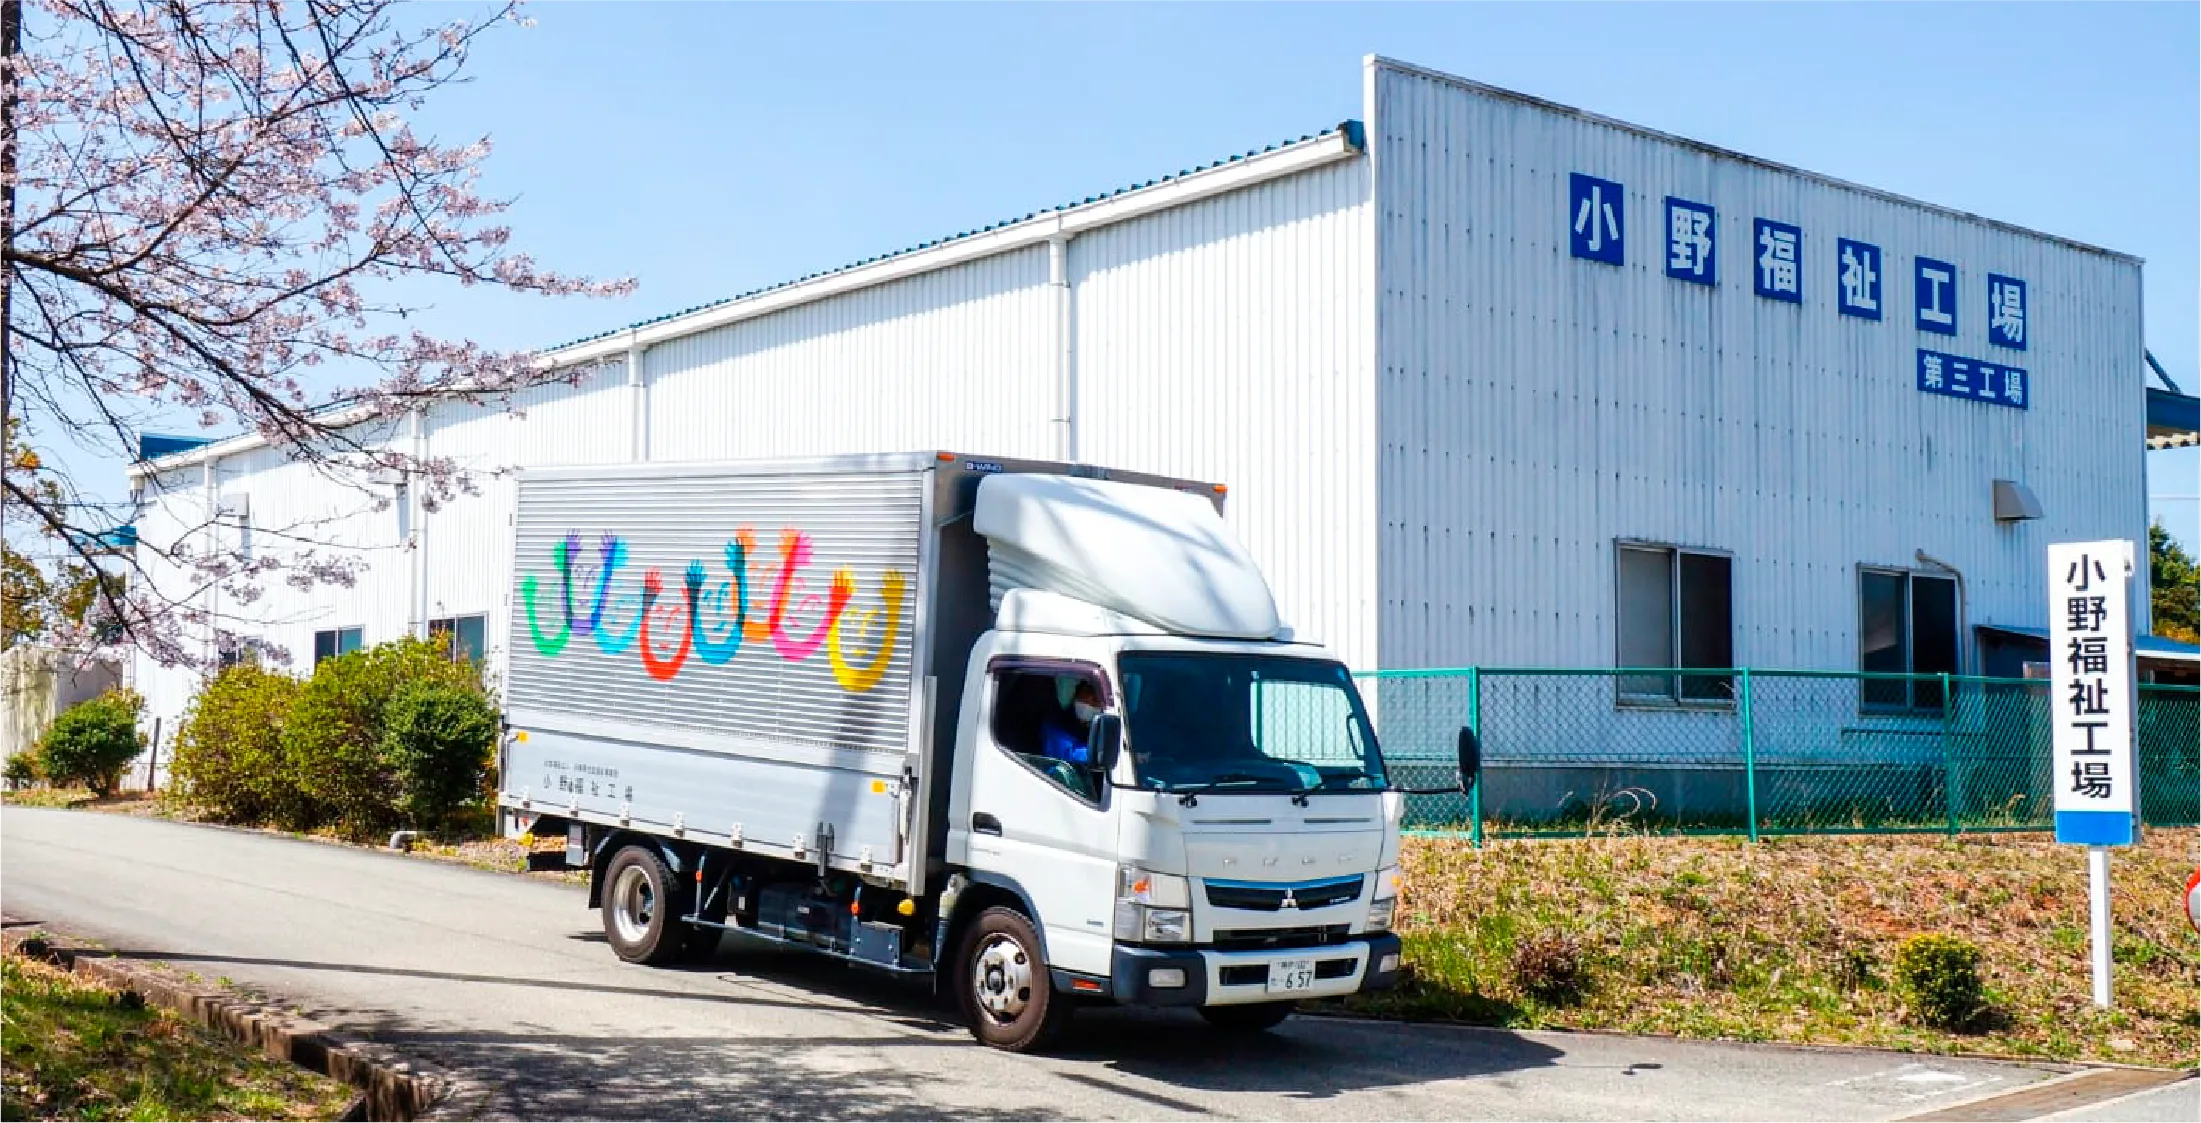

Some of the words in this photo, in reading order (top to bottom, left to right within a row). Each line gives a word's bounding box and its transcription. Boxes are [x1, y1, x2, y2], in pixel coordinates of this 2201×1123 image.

[1575, 186, 2024, 343] 小野福祉工場
[1922, 354, 2023, 403] 第三工場
[2066, 553, 2113, 799] 小野福祉工場
